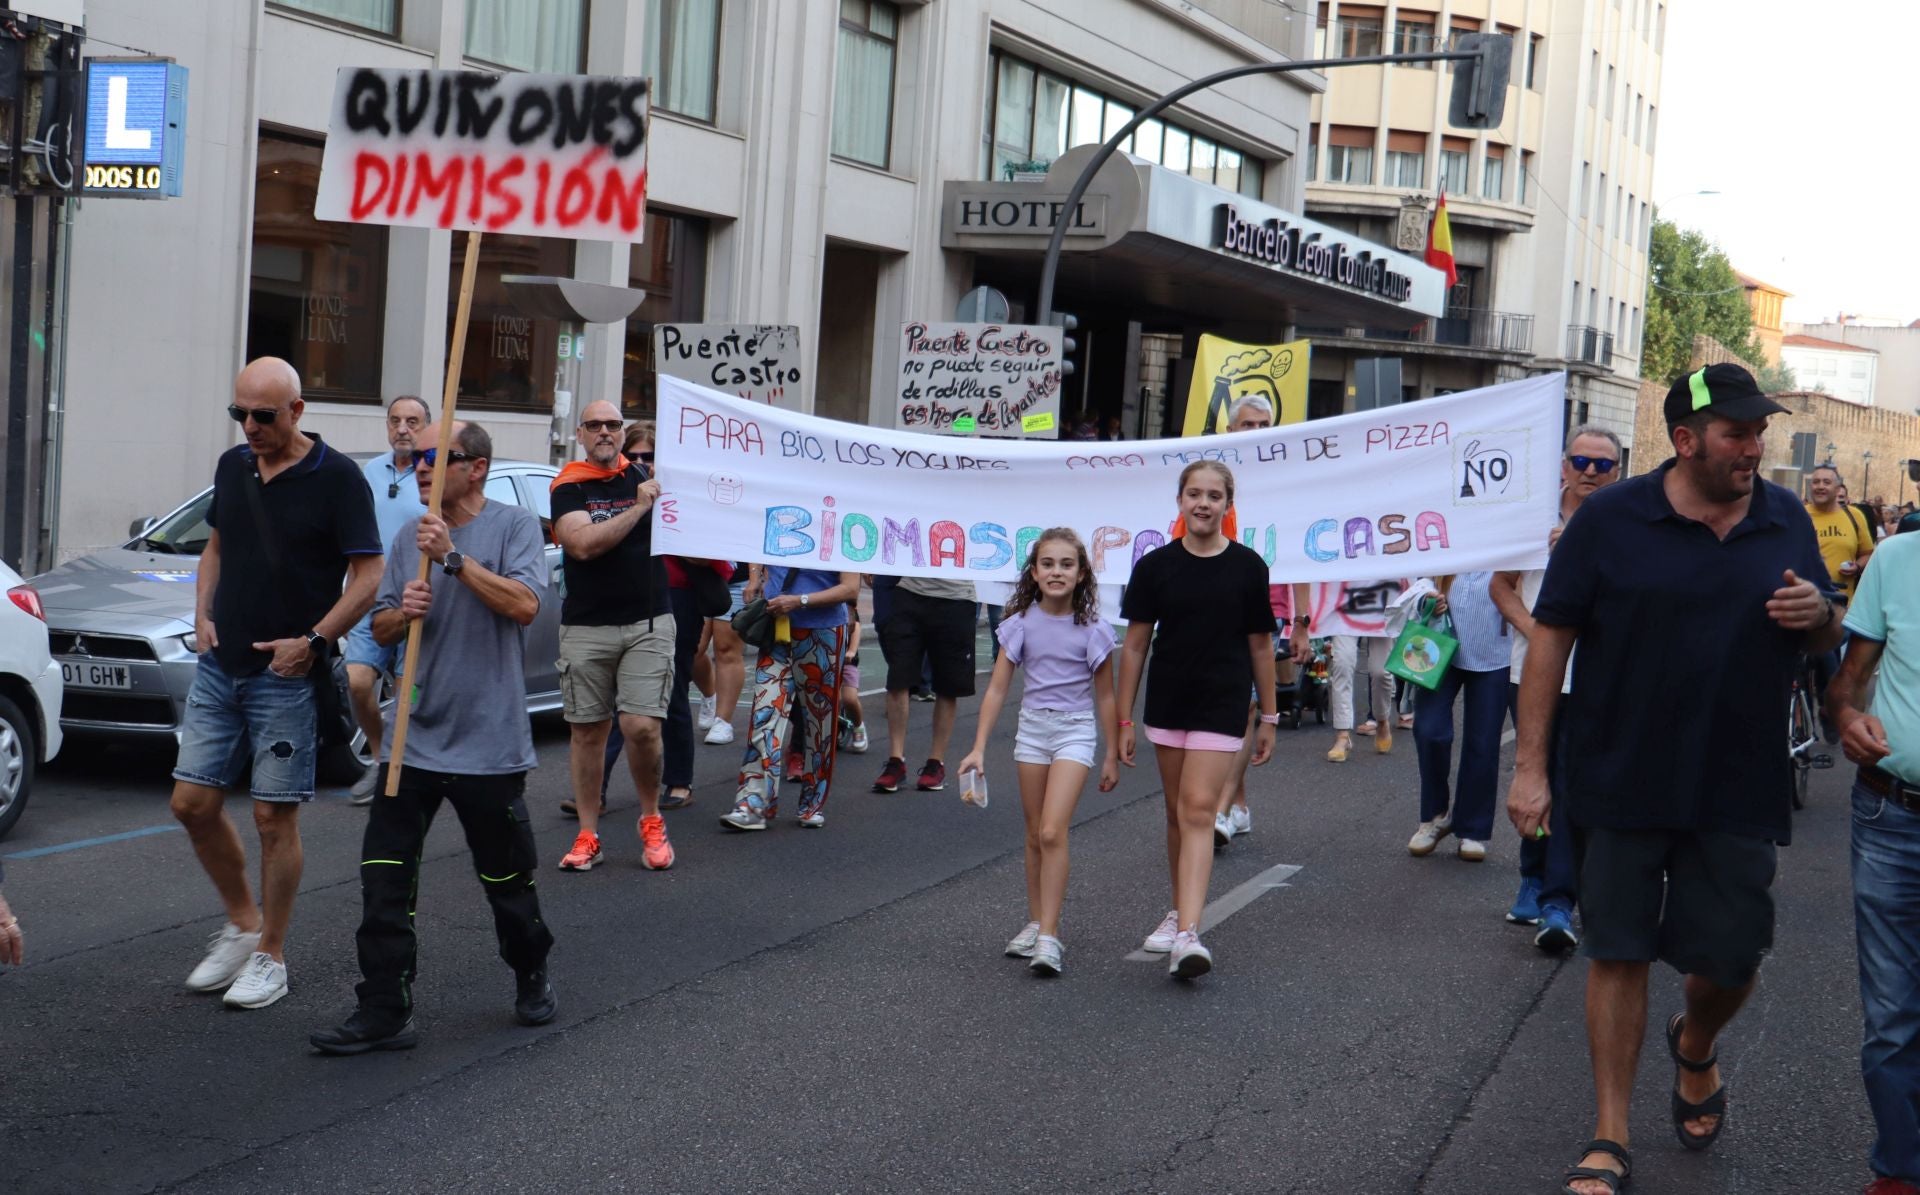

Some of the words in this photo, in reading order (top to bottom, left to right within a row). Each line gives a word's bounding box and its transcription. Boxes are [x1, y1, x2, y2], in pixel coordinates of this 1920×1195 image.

[105, 76, 151, 149] L
[345, 69, 647, 158] QUIÑONES
[136, 167, 161, 189] LO
[350, 146, 646, 233] DIMISIÓN
[961, 201, 1096, 228] HOTEL
[1221, 204, 1289, 265] Barceló
[1337, 243, 1380, 291] Conde
[1382, 259, 1413, 301] Luna
[308, 295, 349, 317] CONDE
[308, 317, 348, 344] LUNA
[499, 315, 530, 336] CONDE
[906, 323, 971, 354] Puente
[977, 326, 1050, 355] Castro
[497, 337, 529, 361] LUNA
[663, 325, 758, 361] Puente
[711, 356, 801, 386] Castro
[903, 359, 924, 376] no
[928, 353, 985, 379] puede
[990, 358, 1055, 384] seguir
[902, 380, 921, 400] de
[926, 377, 1002, 399] rodillas
[902, 404, 927, 426] es
[977, 400, 1000, 428] de
[679, 407, 763, 456] PARA
[835, 440, 885, 467] LOS
[1066, 453, 1144, 470] PARA
[1256, 442, 1287, 462] LA
[1303, 435, 1341, 461] DE
[1460, 457, 1508, 497] NO
[1304, 511, 1449, 563] CASA
[1815, 525, 1847, 537] alk.
